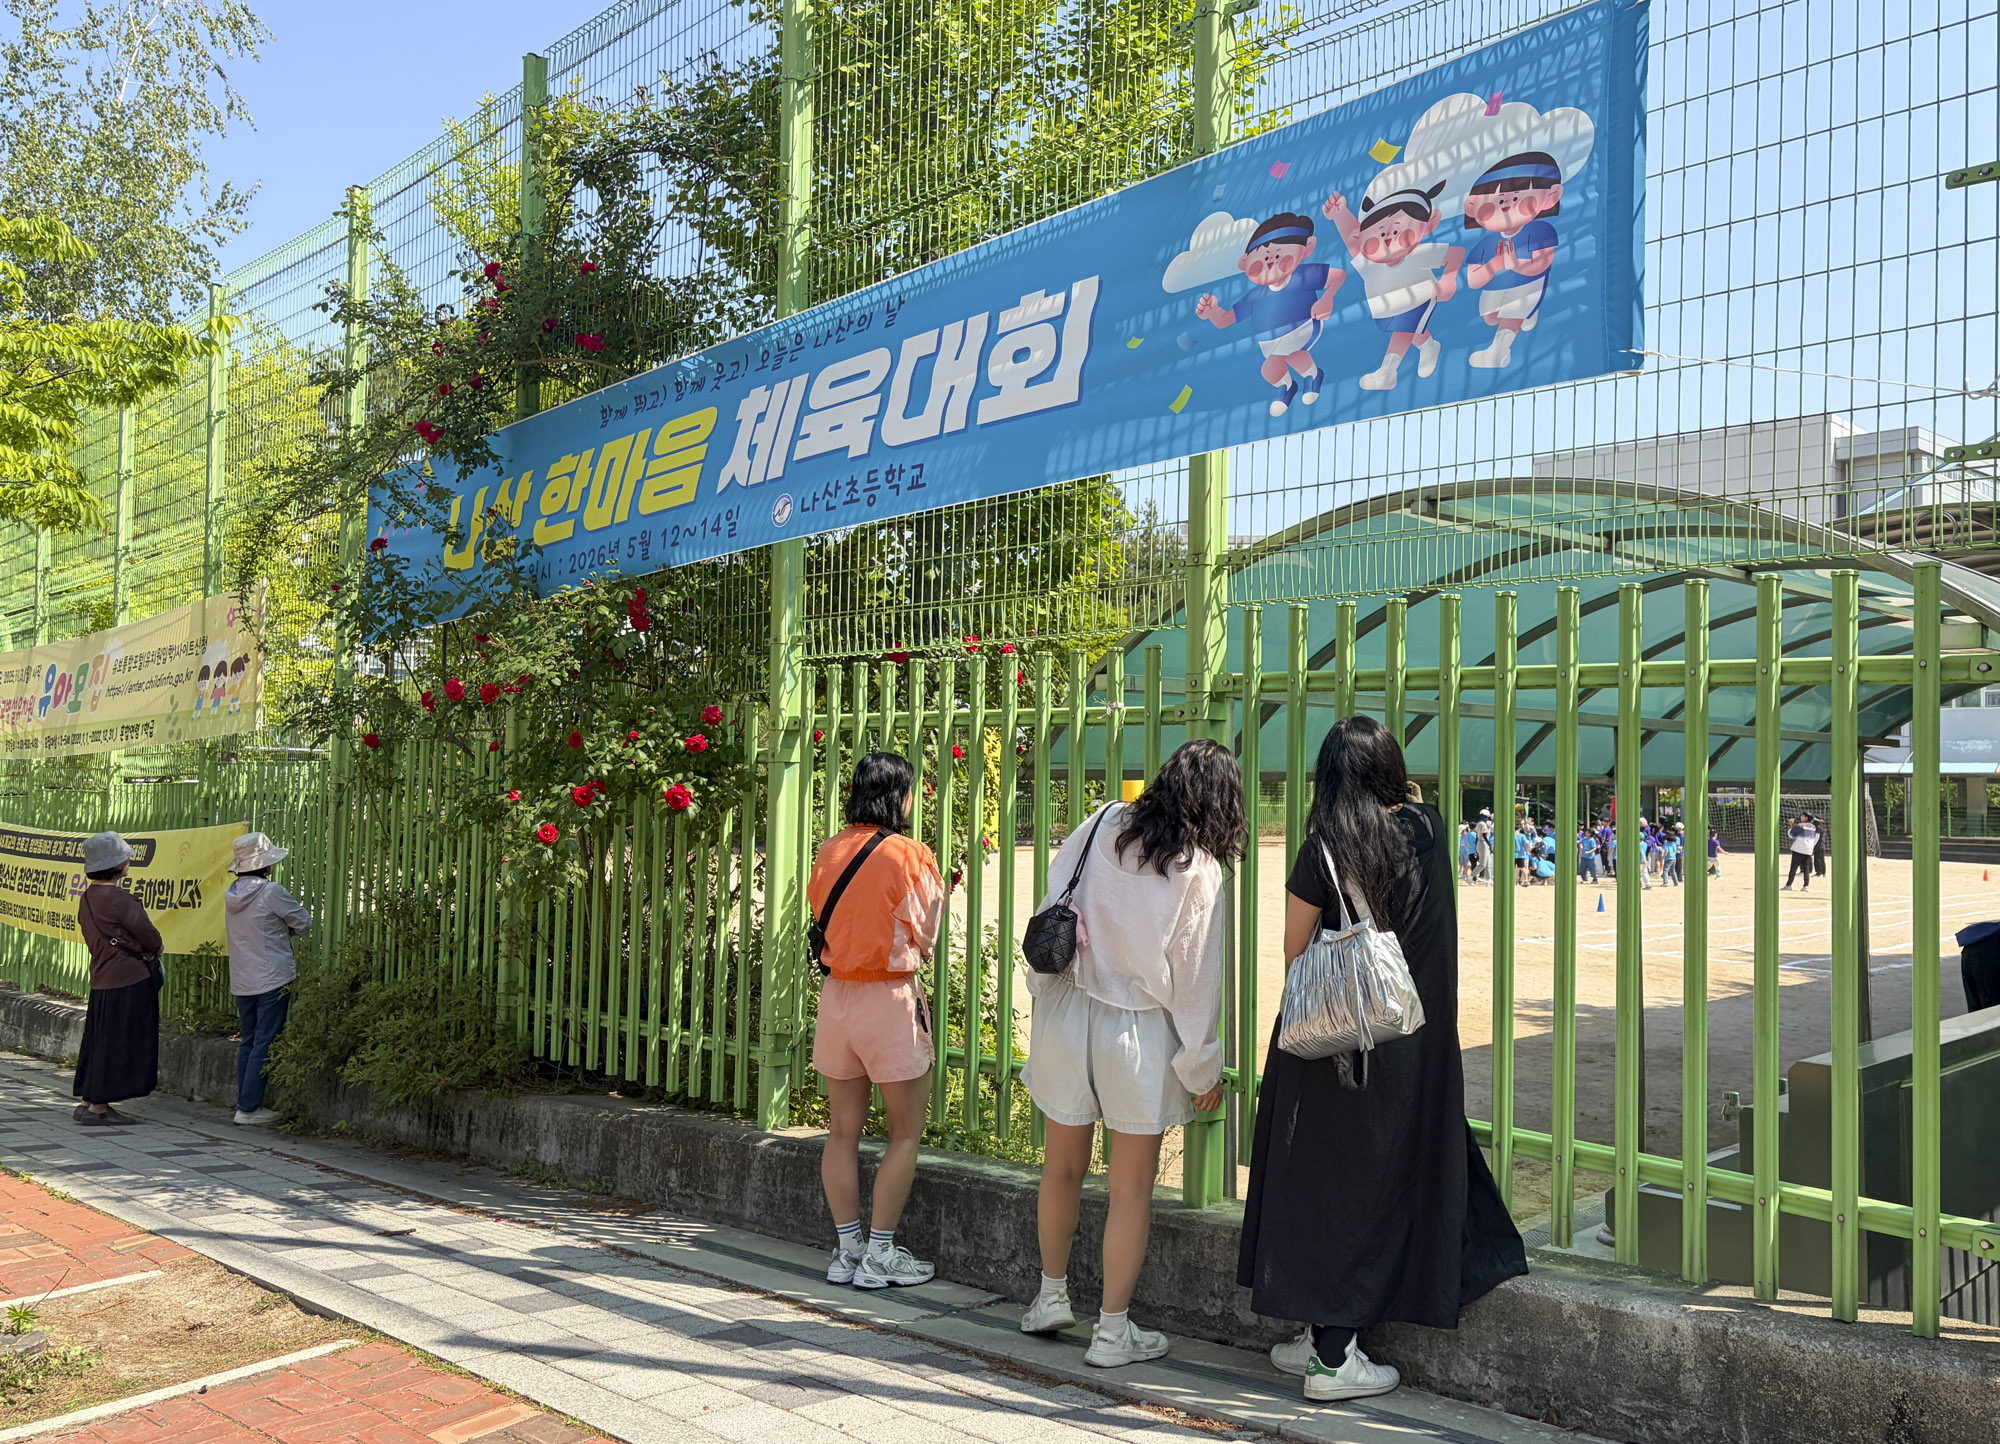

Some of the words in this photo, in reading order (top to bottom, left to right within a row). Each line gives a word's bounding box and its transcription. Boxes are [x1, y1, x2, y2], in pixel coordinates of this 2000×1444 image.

[599, 405, 627, 429] 함께
[633, 385, 668, 414] 뛰고!
[674, 375, 705, 402] 함께
[710, 358, 749, 393] 웃고!
[754, 333, 806, 373] 오늘은
[813, 311, 873, 349] 나산의
[884, 295, 905, 330] 날
[532, 406, 718, 546] 한마음
[716, 274, 1100, 494] 체육대회
[801, 462, 927, 513] 나산초등학교
[569, 537, 620, 575] 2026년
[626, 529, 651, 562] 5월
[660, 504, 741, 550] 12~14일
[37, 653, 111, 719] 유아모집
[17, 866, 49, 897] 창업경진
